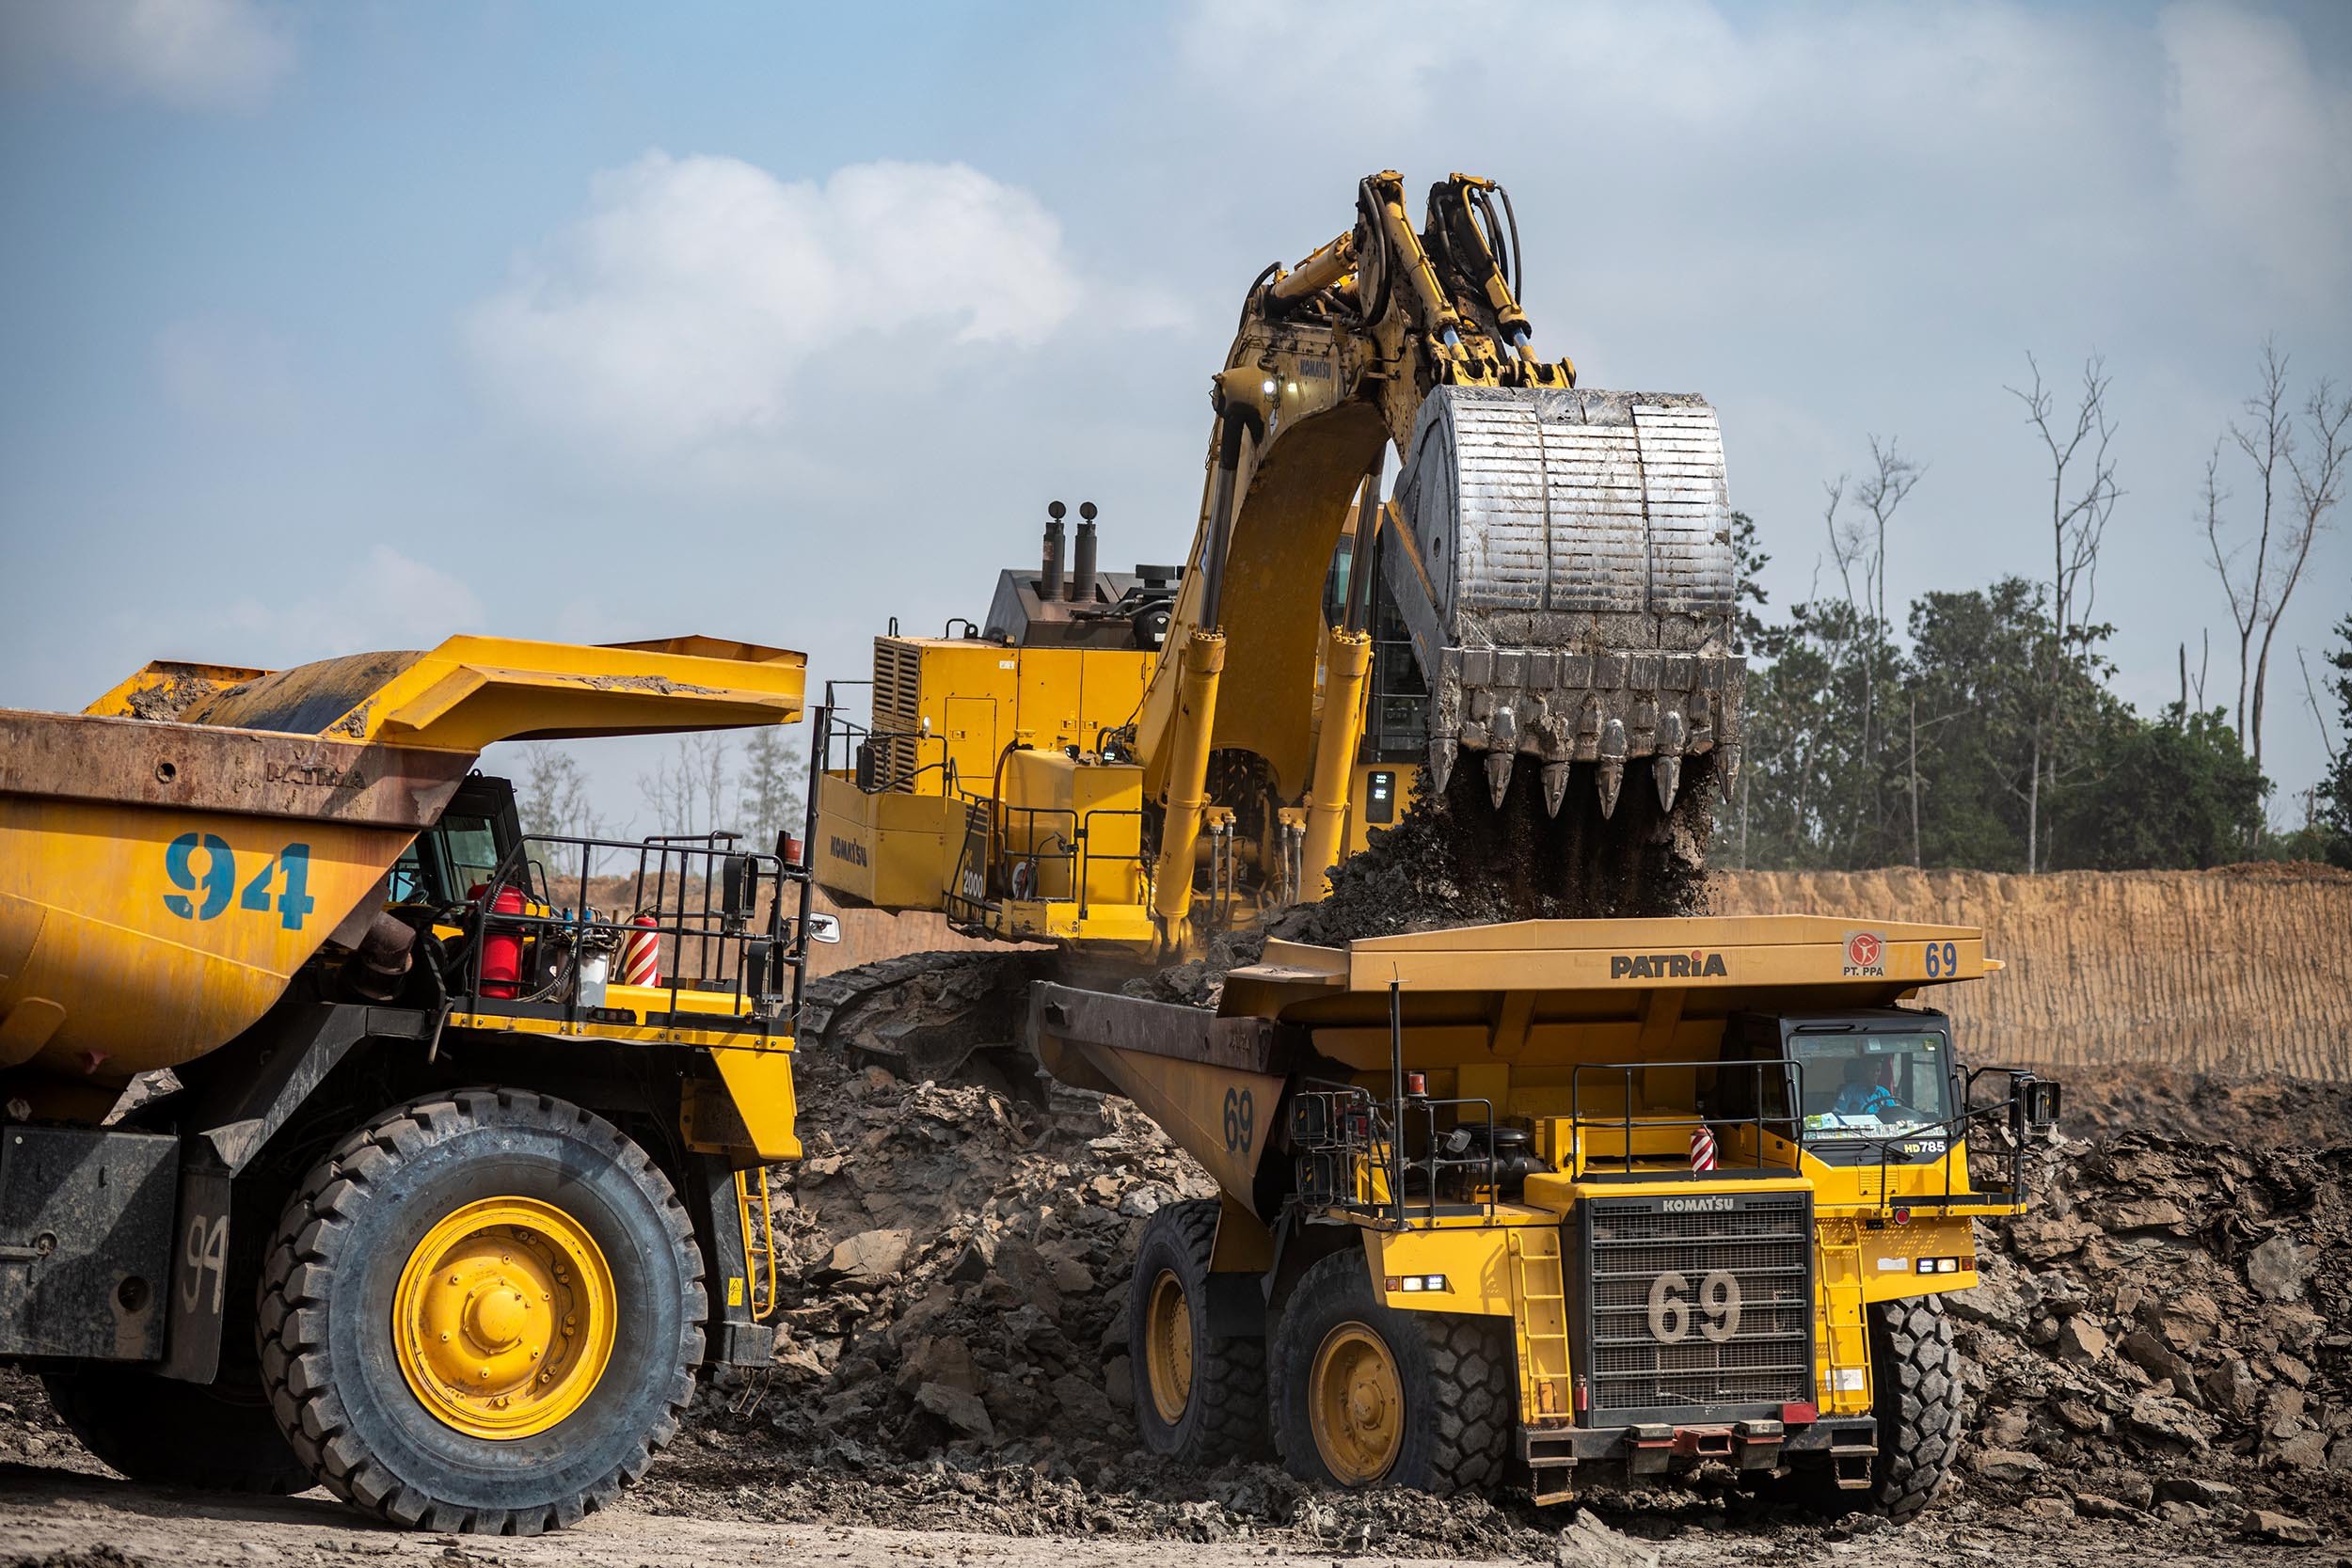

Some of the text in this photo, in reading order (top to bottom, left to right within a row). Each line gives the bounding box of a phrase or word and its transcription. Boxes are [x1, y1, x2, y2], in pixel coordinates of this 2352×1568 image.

[830, 834, 867, 868] KOMATSU
[163, 832, 314, 930] 94
[962, 869, 983, 899] 2000
[1843, 966, 1883, 976] PT. PPA
[1925, 942, 1957, 978] 69
[1224, 1087, 1253, 1153] 69
[1662, 1196, 1734, 1212] KOMATSU
[183, 1214, 228, 1315] 94
[1647, 1270, 1741, 1345] 69
